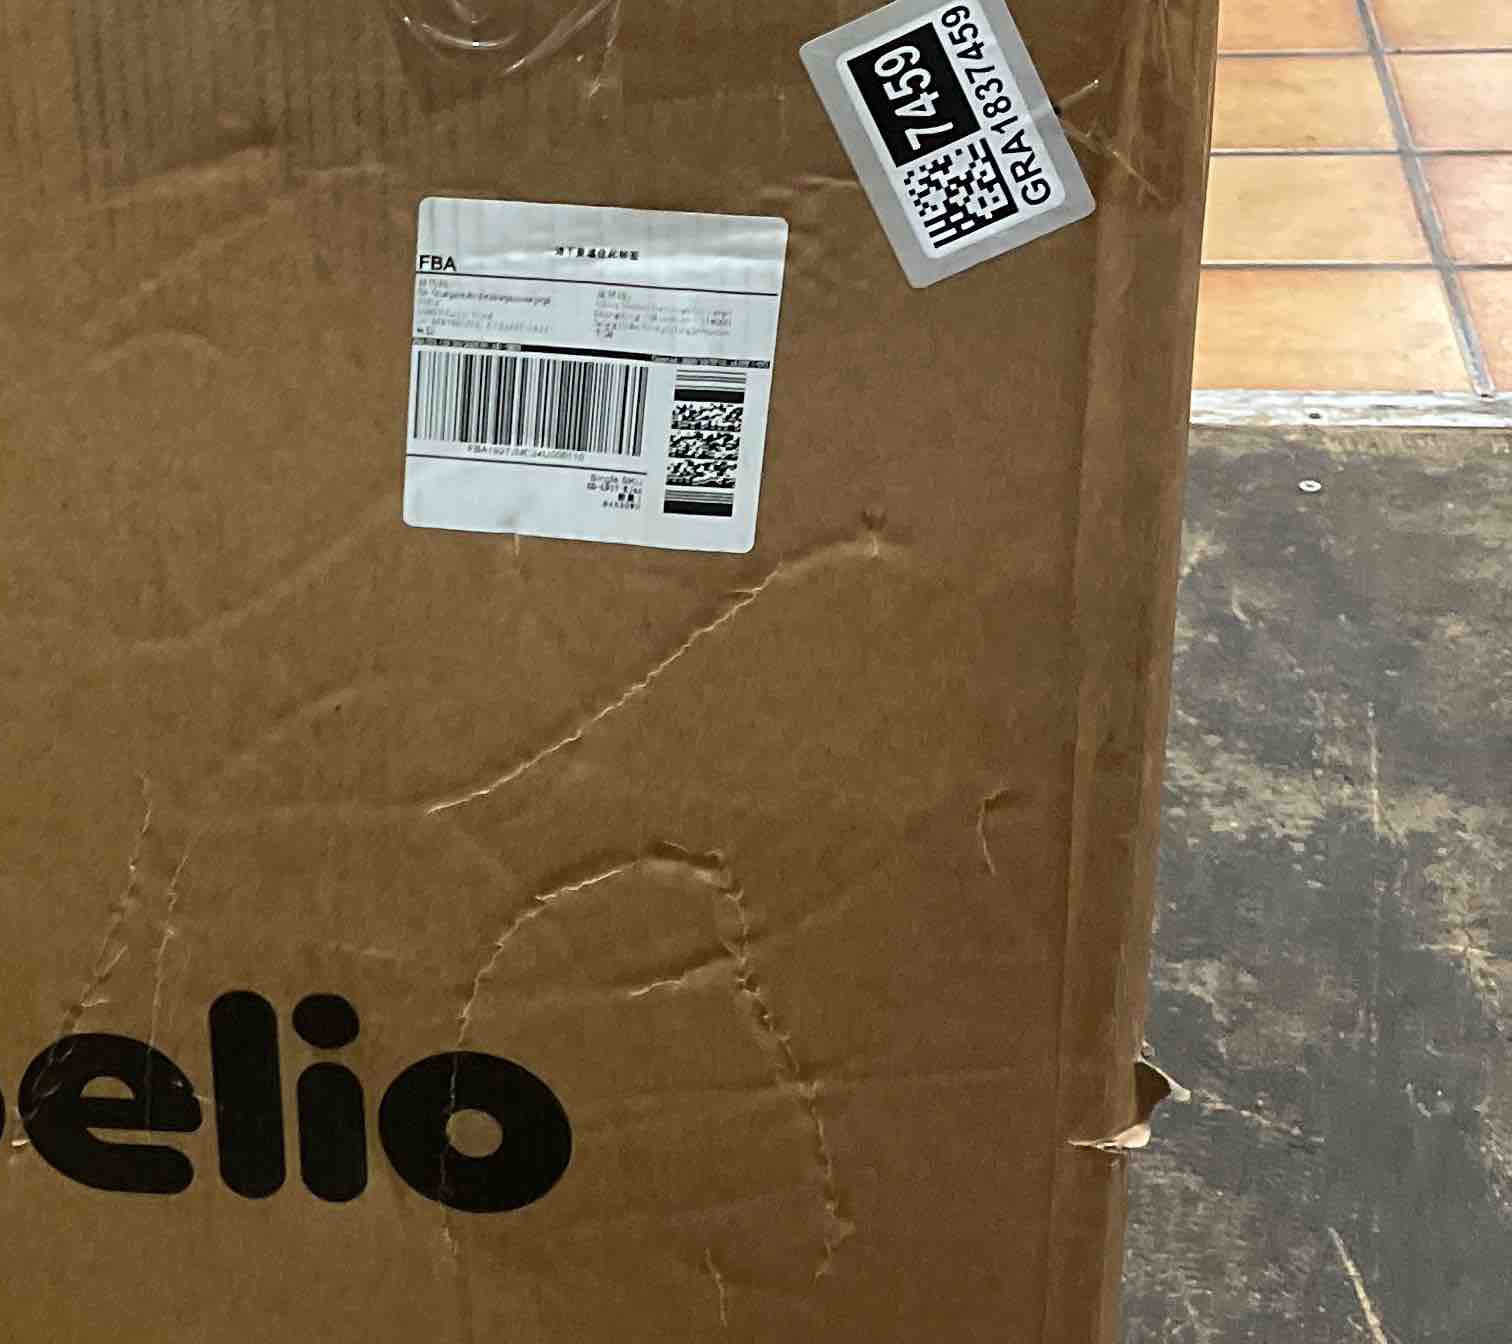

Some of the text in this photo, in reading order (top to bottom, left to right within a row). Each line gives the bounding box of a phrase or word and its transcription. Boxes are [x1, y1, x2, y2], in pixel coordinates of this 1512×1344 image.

[874, 45, 954, 151] 7459
[941, 5, 1051, 206] GRA1837459
[418, 254, 457, 271] FBA
